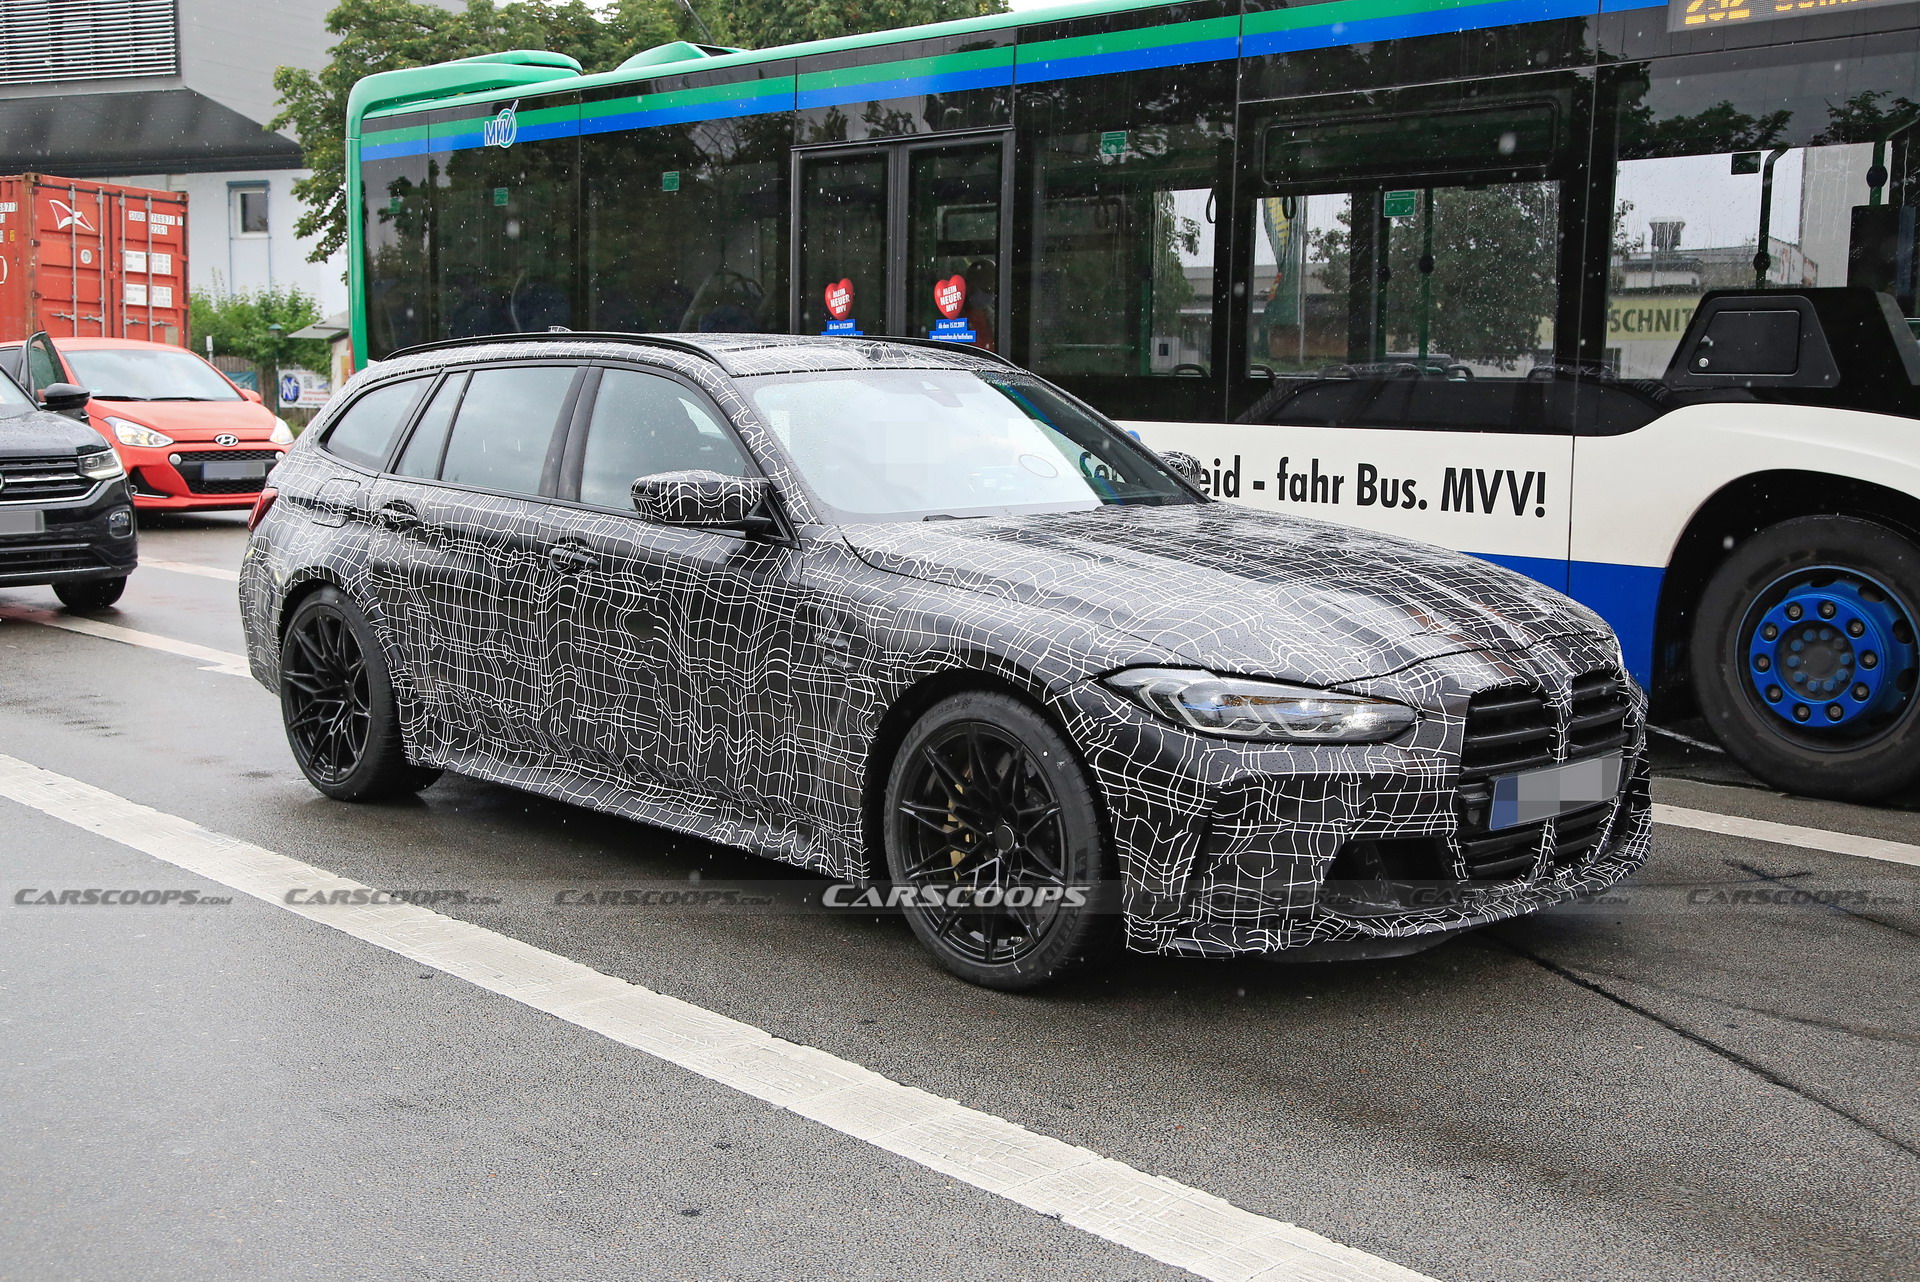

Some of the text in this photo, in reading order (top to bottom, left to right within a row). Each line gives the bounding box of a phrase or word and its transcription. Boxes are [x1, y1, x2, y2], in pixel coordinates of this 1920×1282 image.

[832, 288, 846, 299] MEIN
[943, 285, 957, 296] MEIN
[830, 294, 850, 308] NEUER
[940, 292, 962, 305] NEUER
[836, 305, 847, 314] MVV
[946, 303, 958, 312] MVV
[1277, 456, 1345, 504] fahr
[1356, 462, 1428, 511] Bus.
[1440, 466, 1546, 518] MVV!
